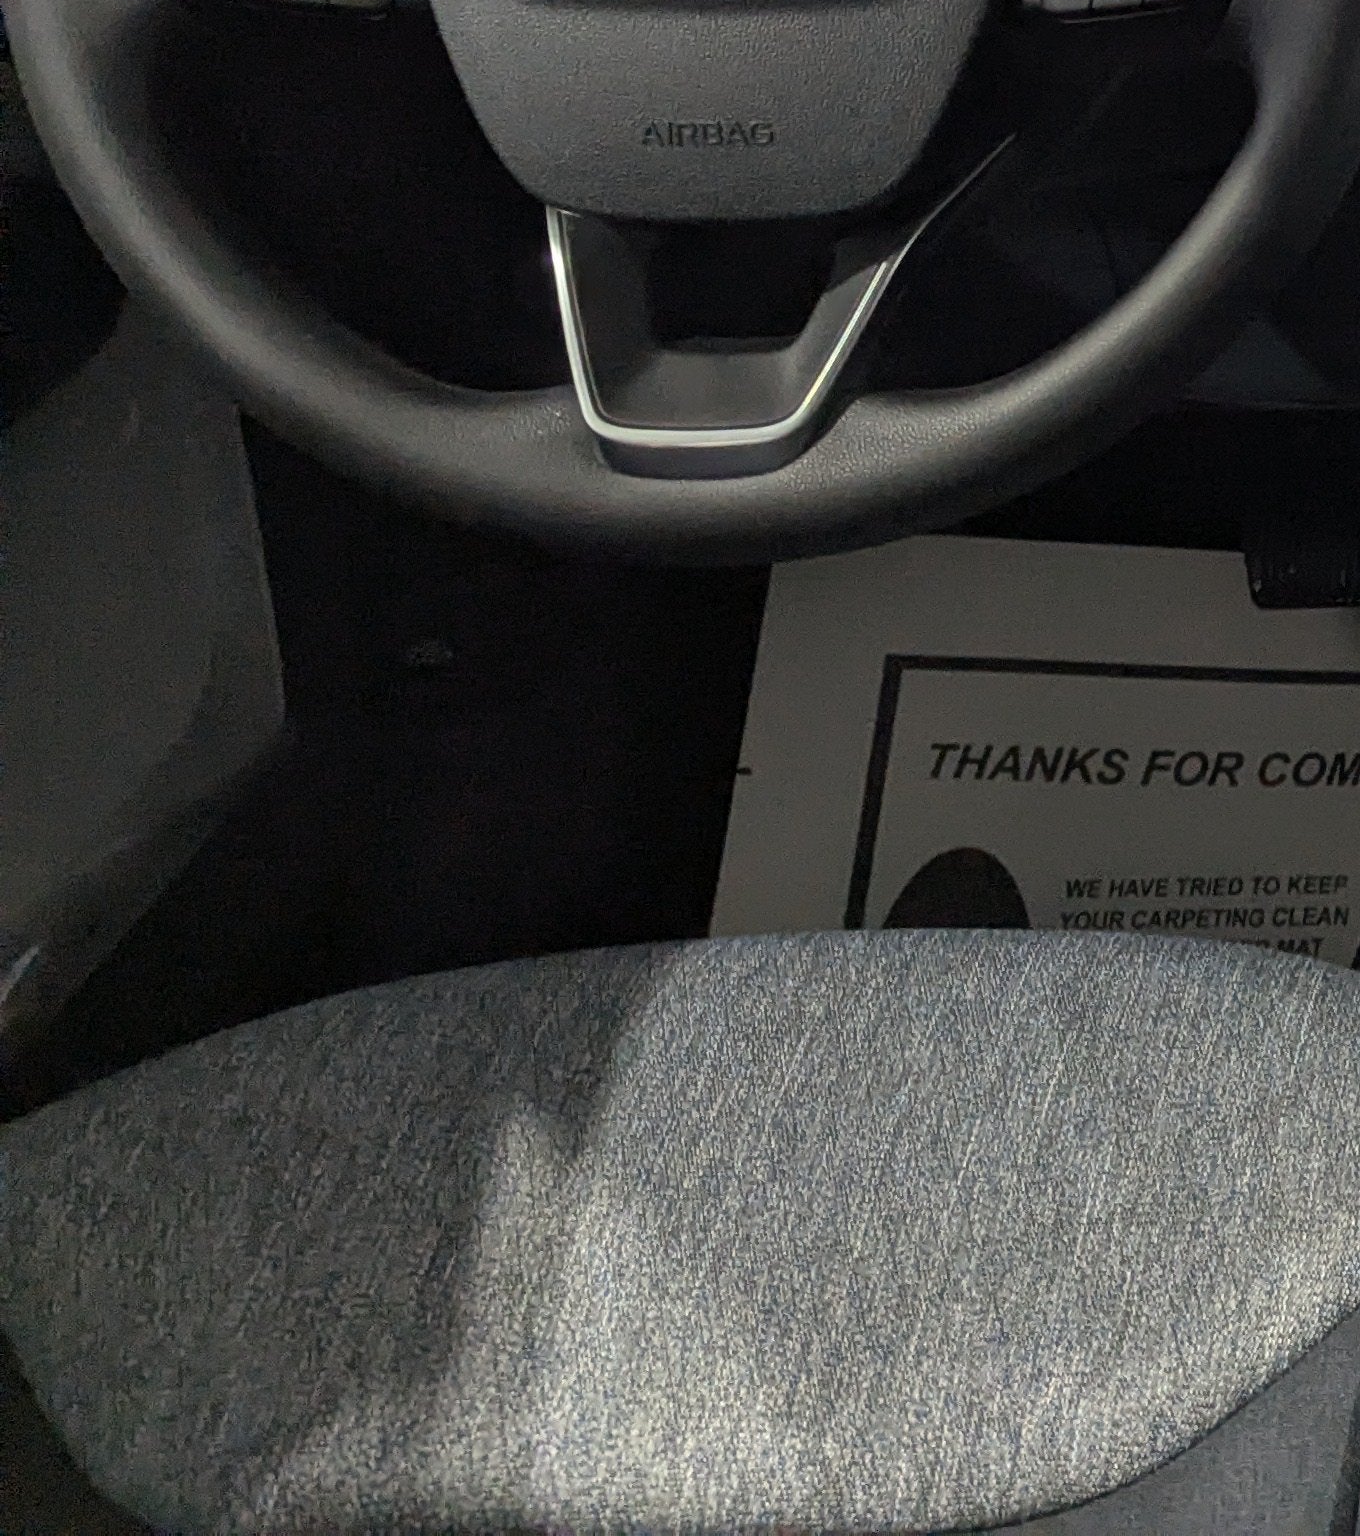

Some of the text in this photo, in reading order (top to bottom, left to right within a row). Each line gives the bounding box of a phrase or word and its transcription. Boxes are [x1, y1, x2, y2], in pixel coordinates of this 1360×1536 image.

[642, 122, 774, 148] AIRBAG
[929, 743, 1129, 785] THANKS
[1140, 749, 1244, 786] FOR
[1066, 874, 1348, 898] WE HAVE TRIED TO KEEP
[1060, 906, 1349, 930] YOUR CARPETING CLEAN
